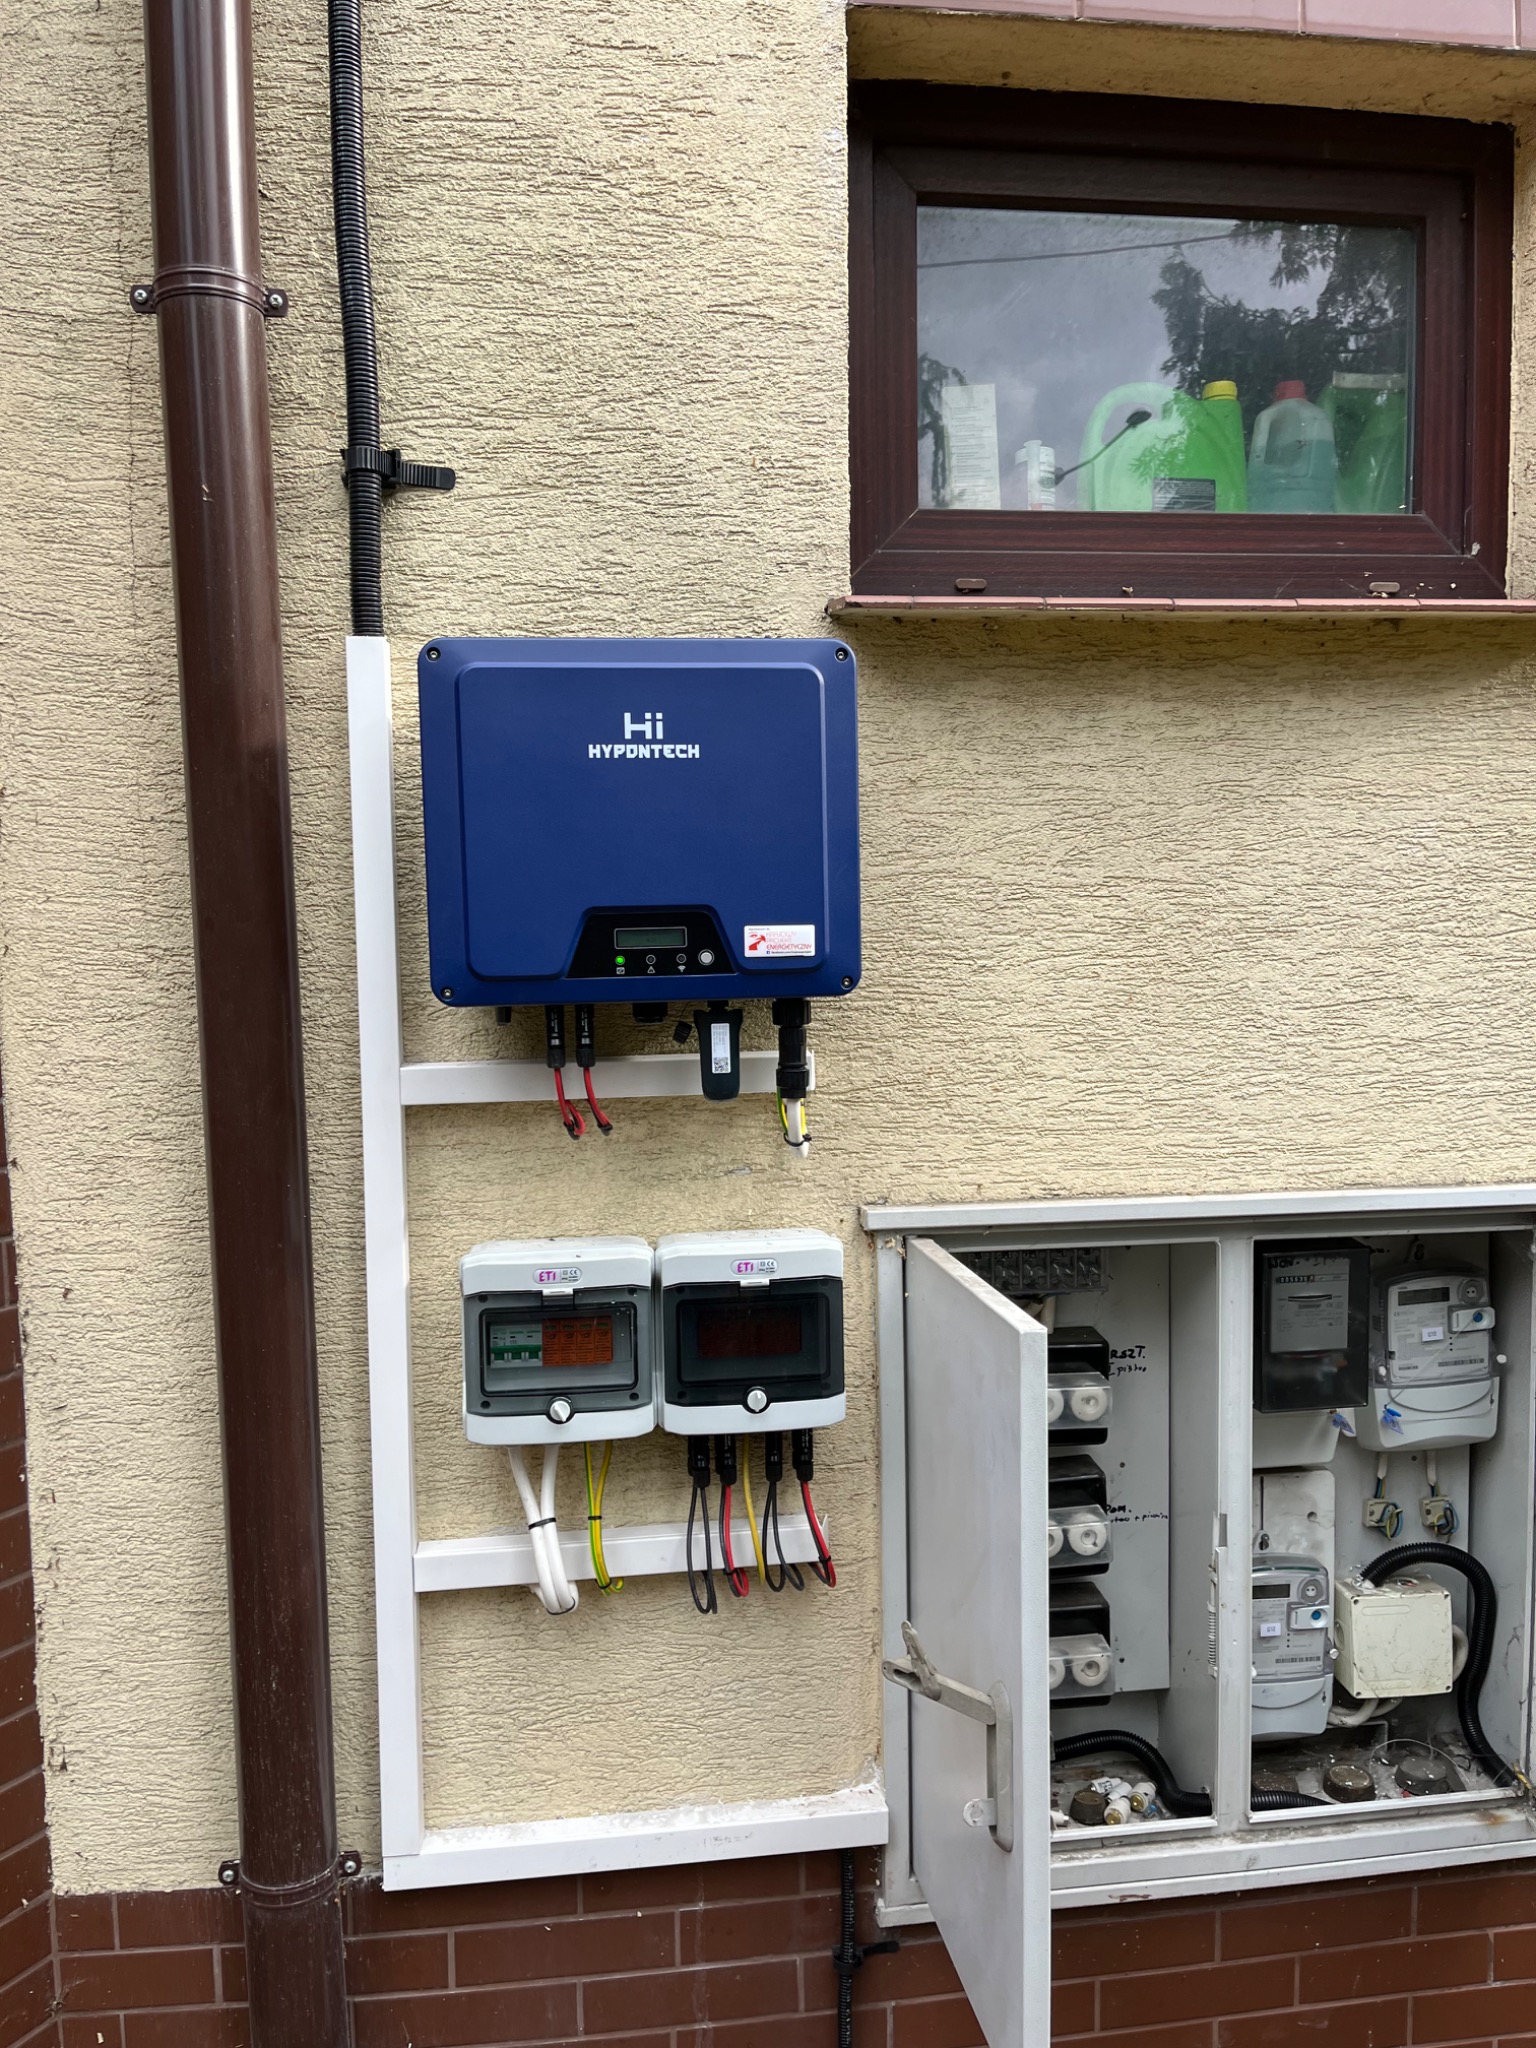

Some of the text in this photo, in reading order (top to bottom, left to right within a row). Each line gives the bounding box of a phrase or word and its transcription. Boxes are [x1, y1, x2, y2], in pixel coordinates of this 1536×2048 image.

[624, 712, 663, 739] Hi
[588, 744, 700, 759] HYPONTECH
[737, 1262, 754, 1273] ETI
[539, 1271, 556, 1282] ETI
